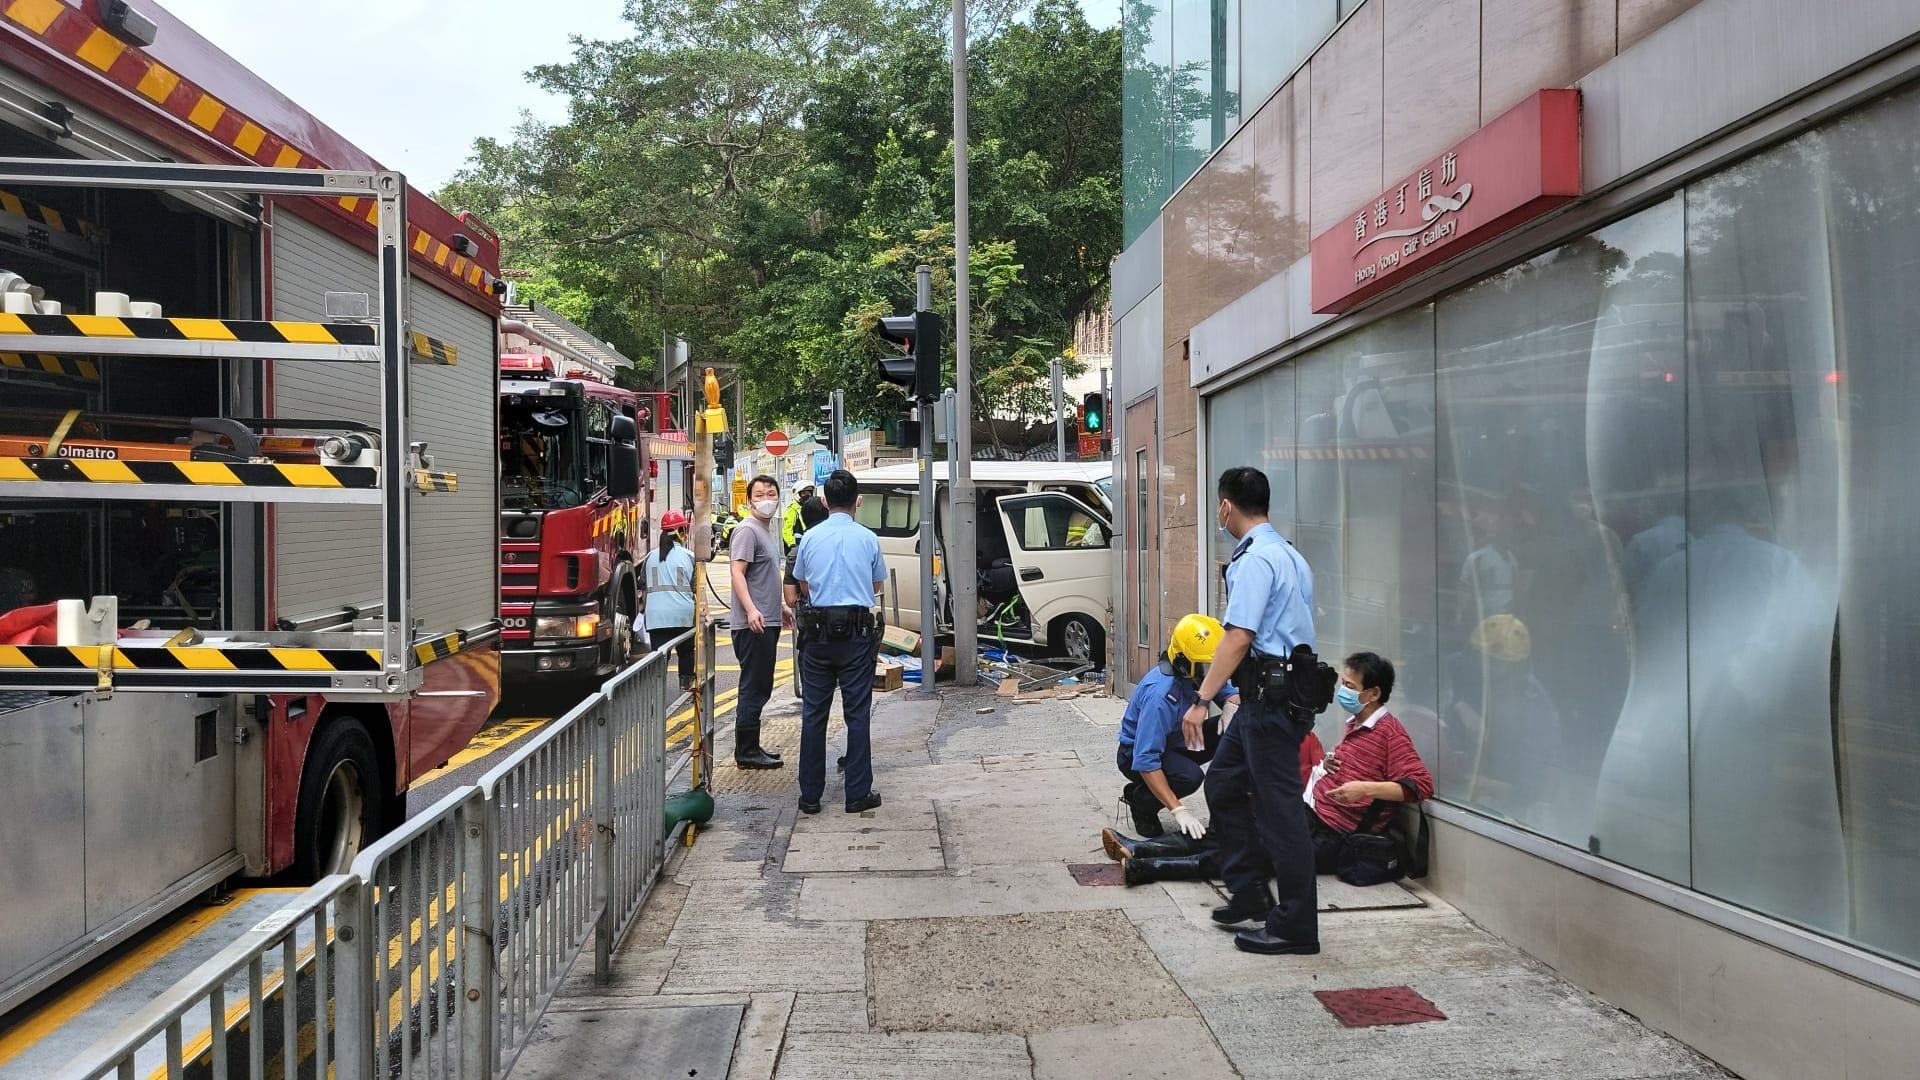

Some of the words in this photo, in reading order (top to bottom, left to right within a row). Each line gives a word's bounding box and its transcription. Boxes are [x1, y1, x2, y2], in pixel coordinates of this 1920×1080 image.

[1355, 264, 1376, 284] Hong
[1379, 250, 1400, 271] Kong
[1402, 237, 1420, 257] Gift
[1422, 218, 1458, 247] Gallery
[59, 446, 116, 459] olmatro
[503, 618, 527, 628] 00
